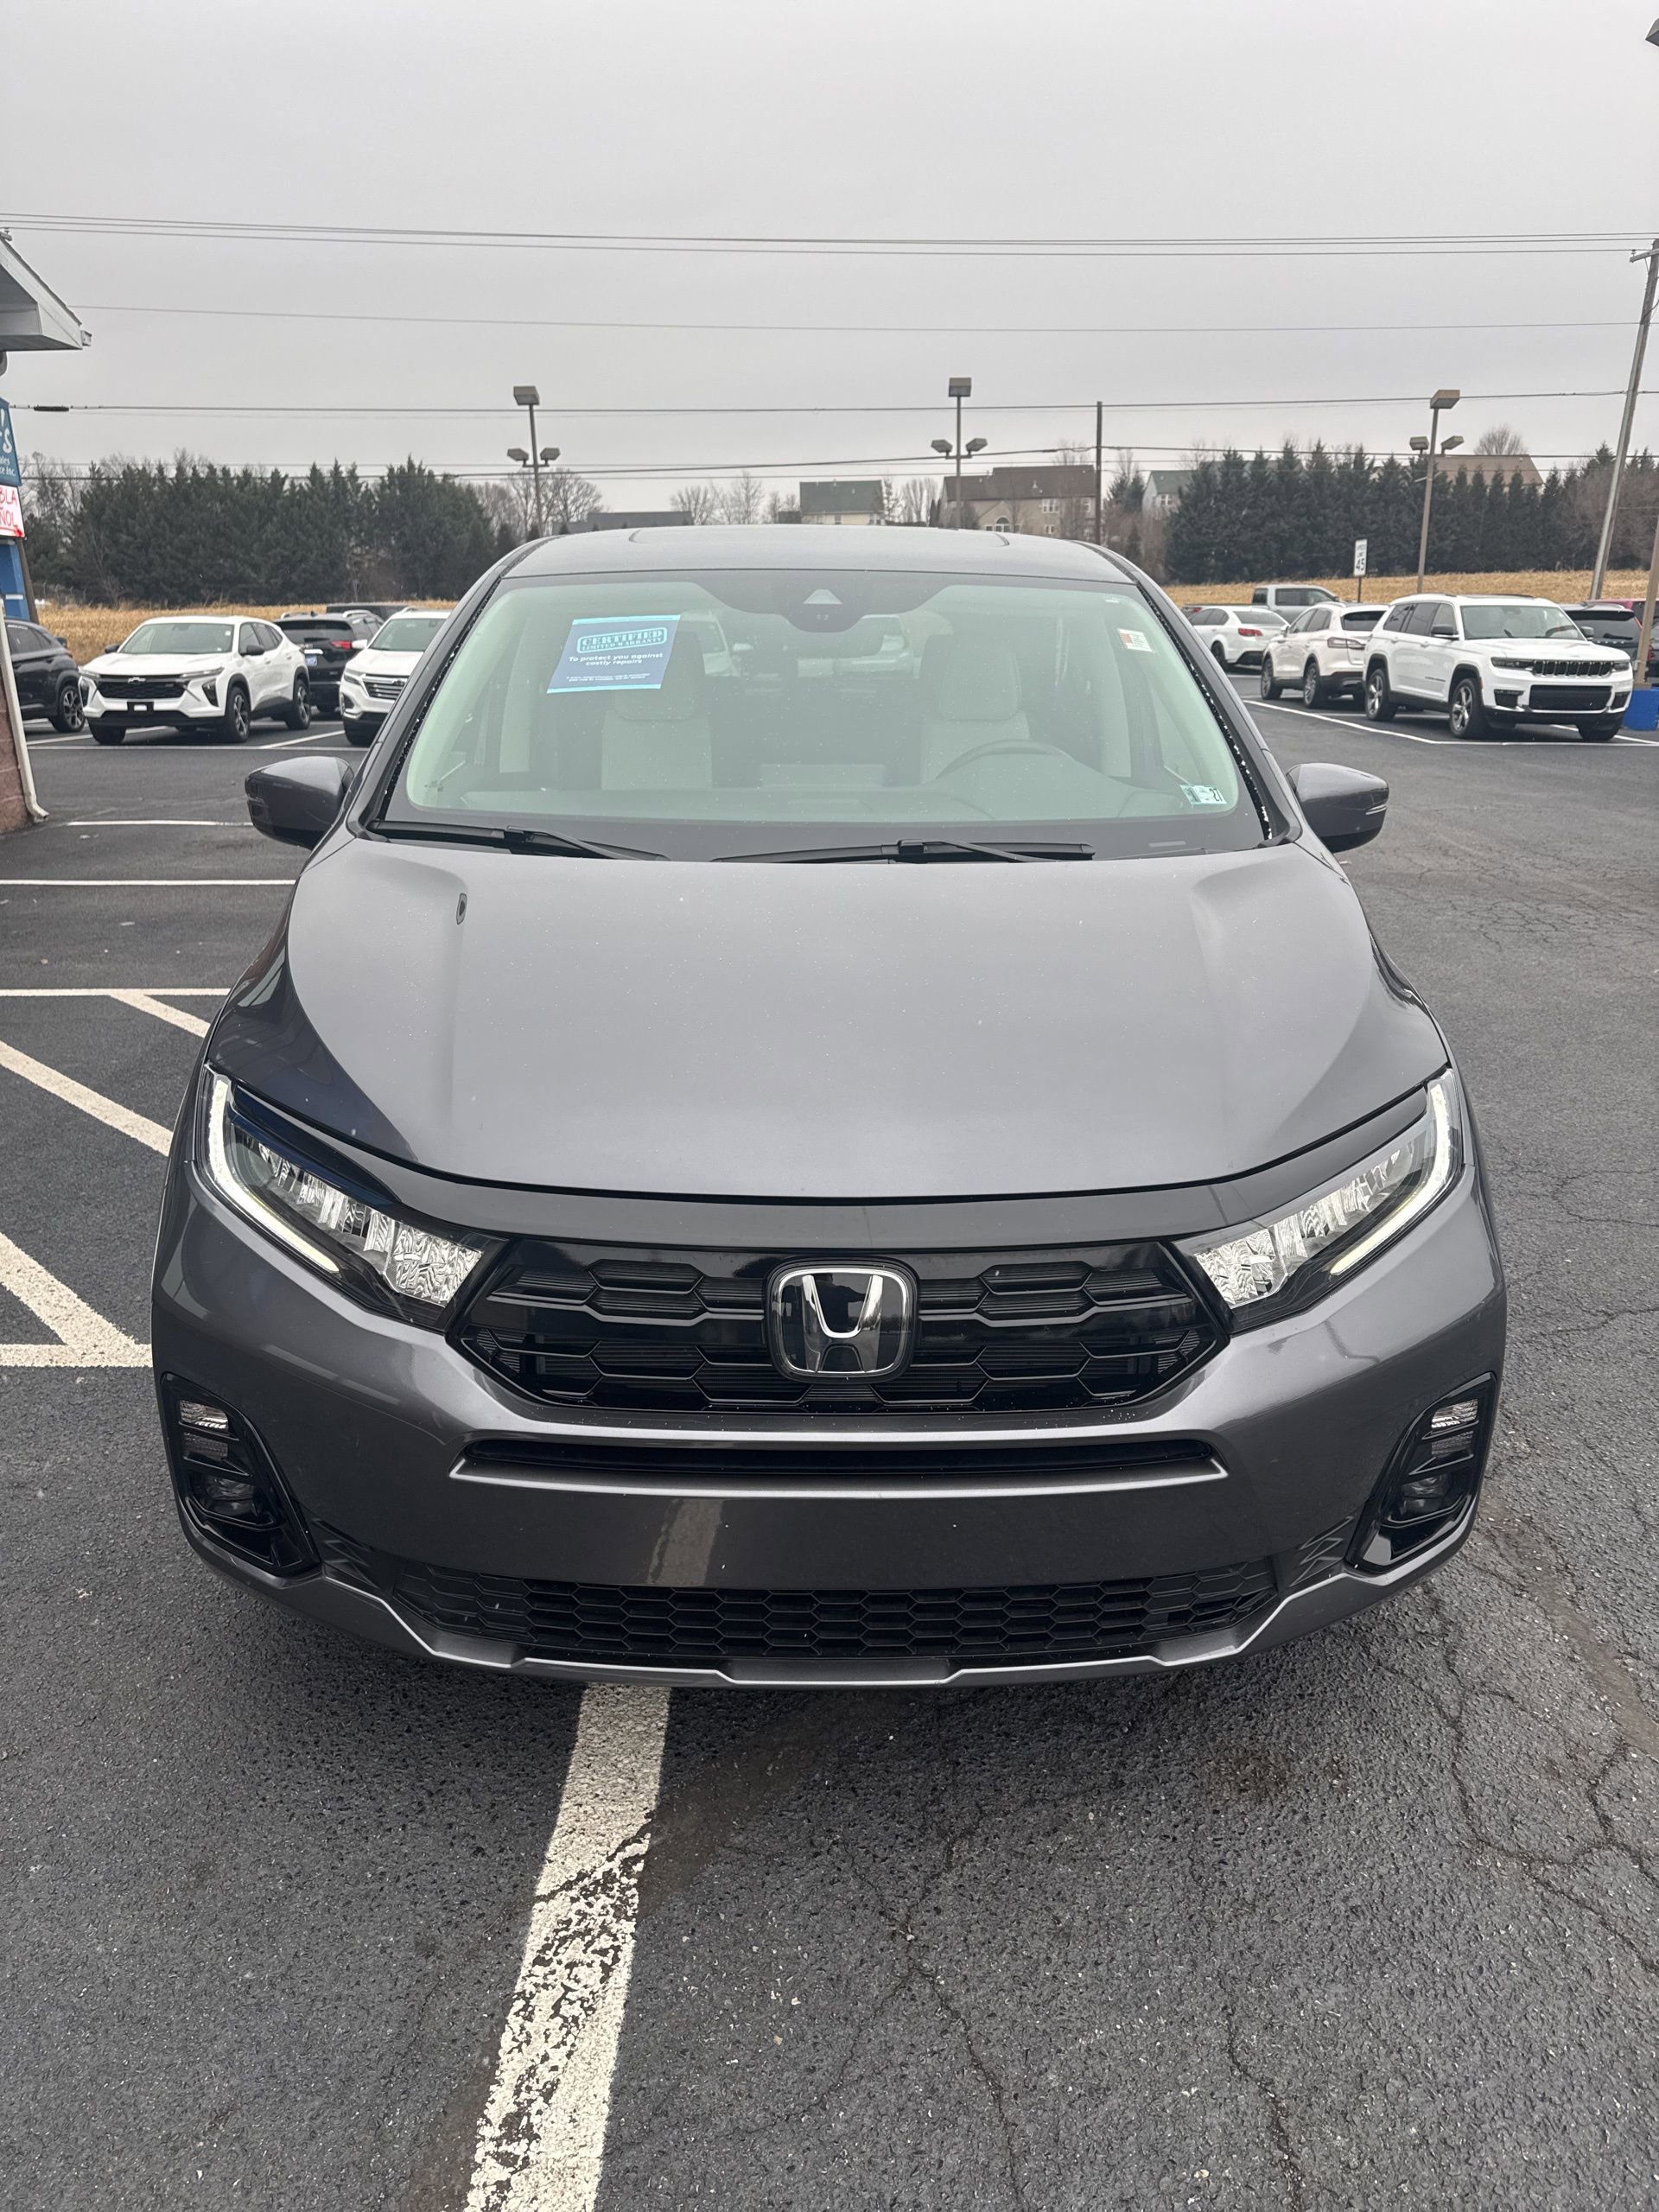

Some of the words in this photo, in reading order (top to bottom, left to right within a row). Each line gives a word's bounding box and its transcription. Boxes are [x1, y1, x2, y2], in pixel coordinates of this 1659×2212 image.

[1356, 558, 1365, 571] 45
[582, 630, 663, 645] CERTIFIED
[618, 638, 662, 647] WARRANTY
[1209, 788, 1223, 802] 27
